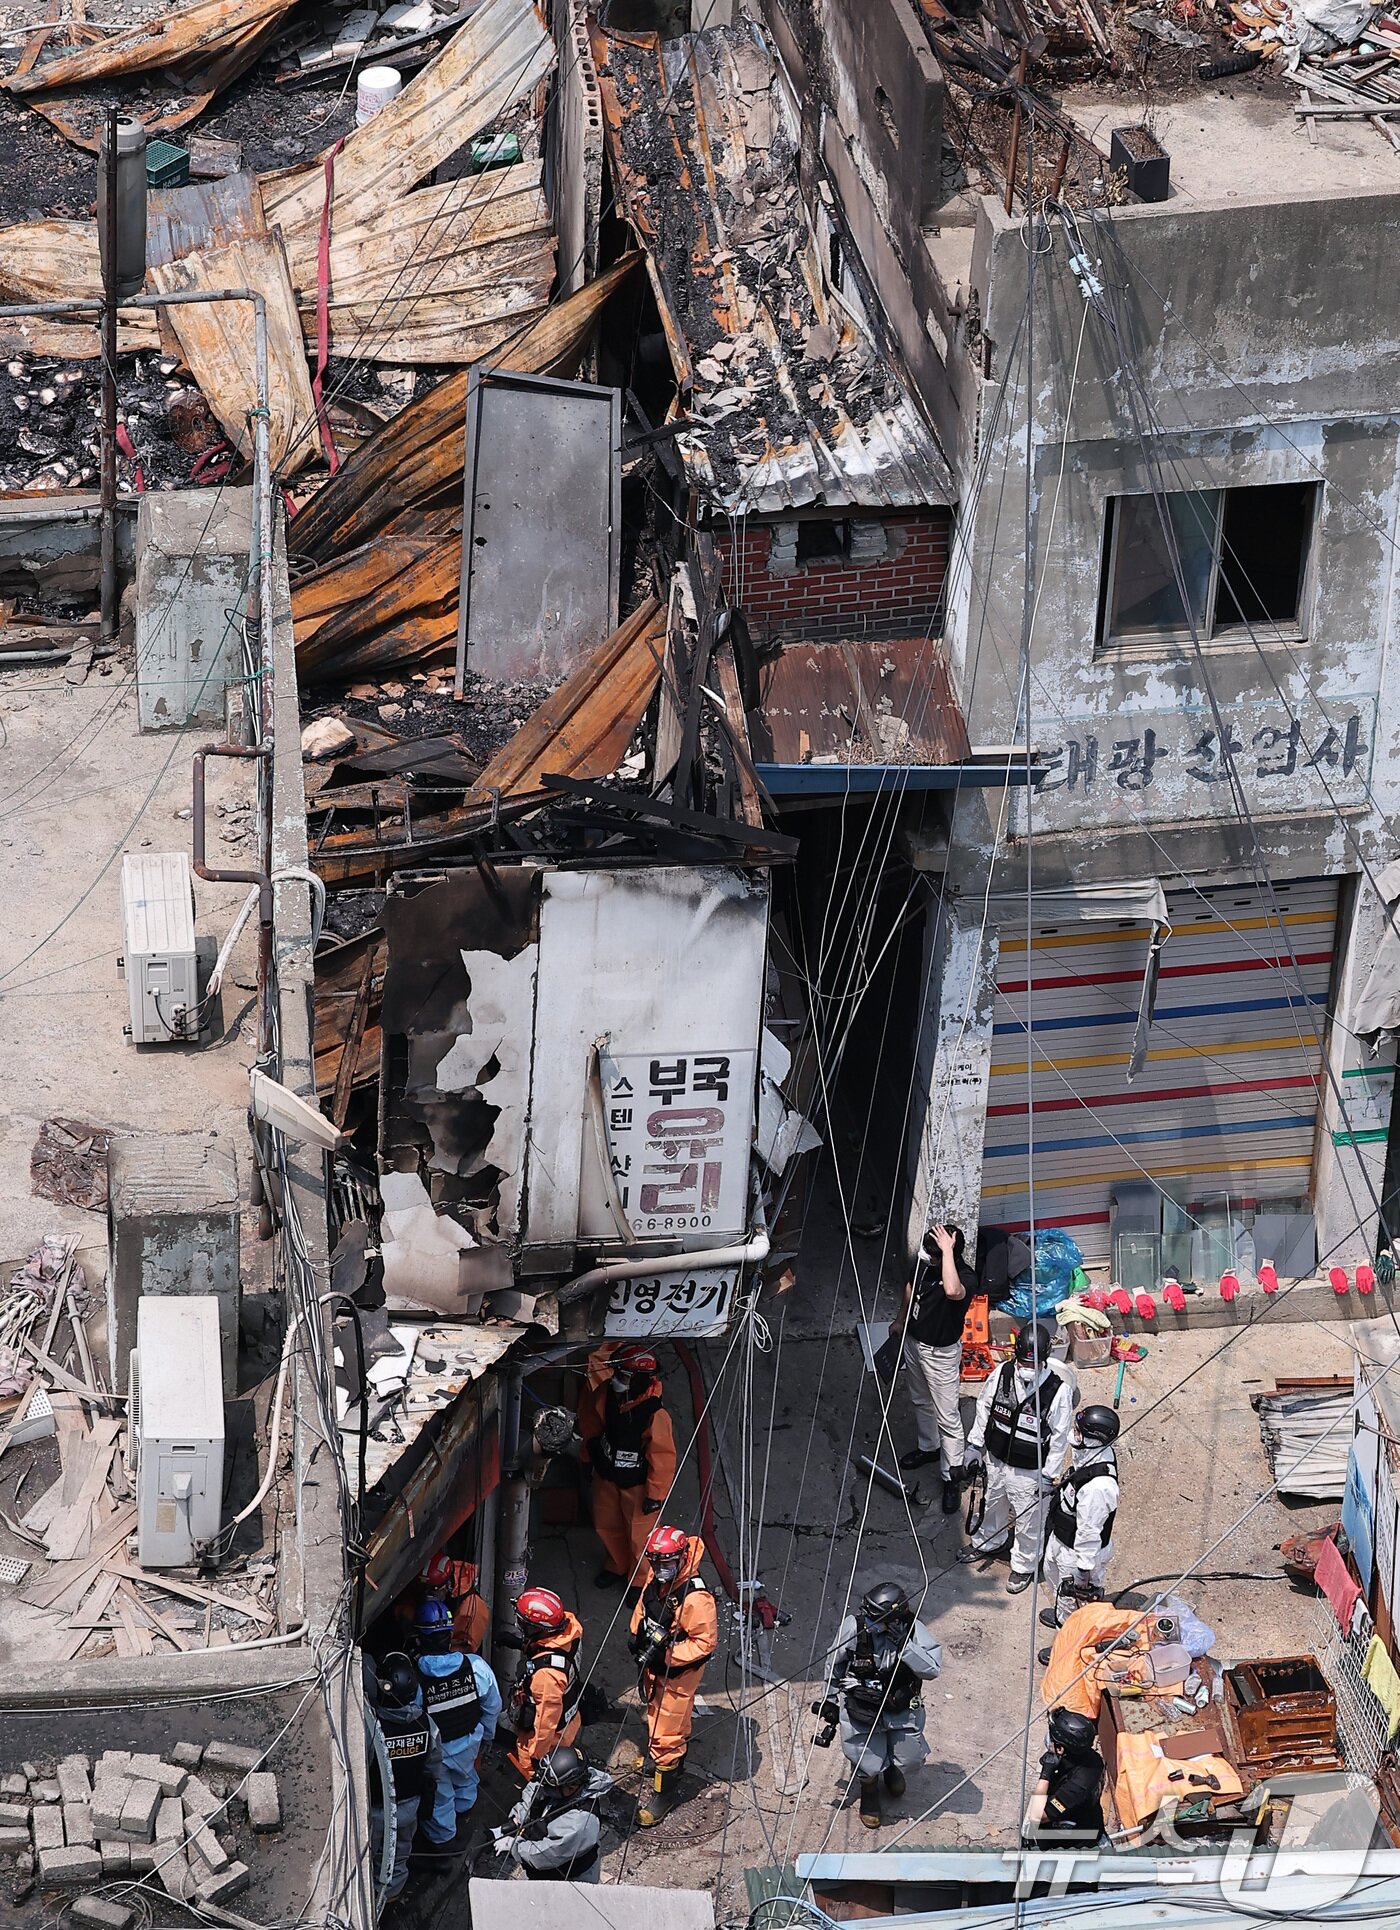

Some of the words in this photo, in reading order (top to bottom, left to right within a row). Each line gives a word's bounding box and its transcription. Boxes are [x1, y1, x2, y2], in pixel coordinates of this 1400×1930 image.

[1034, 715, 1370, 794] 태광산업사
[648, 1056, 731, 1106] 부국
[639, 1107, 725, 1214] 유리
[626, 1214, 712, 1231] 66-8900
[427, 1674, 472, 1695] 사고조사
[386, 1735, 424, 1749] 화재감식
[389, 1744, 420, 1756] POLICE
